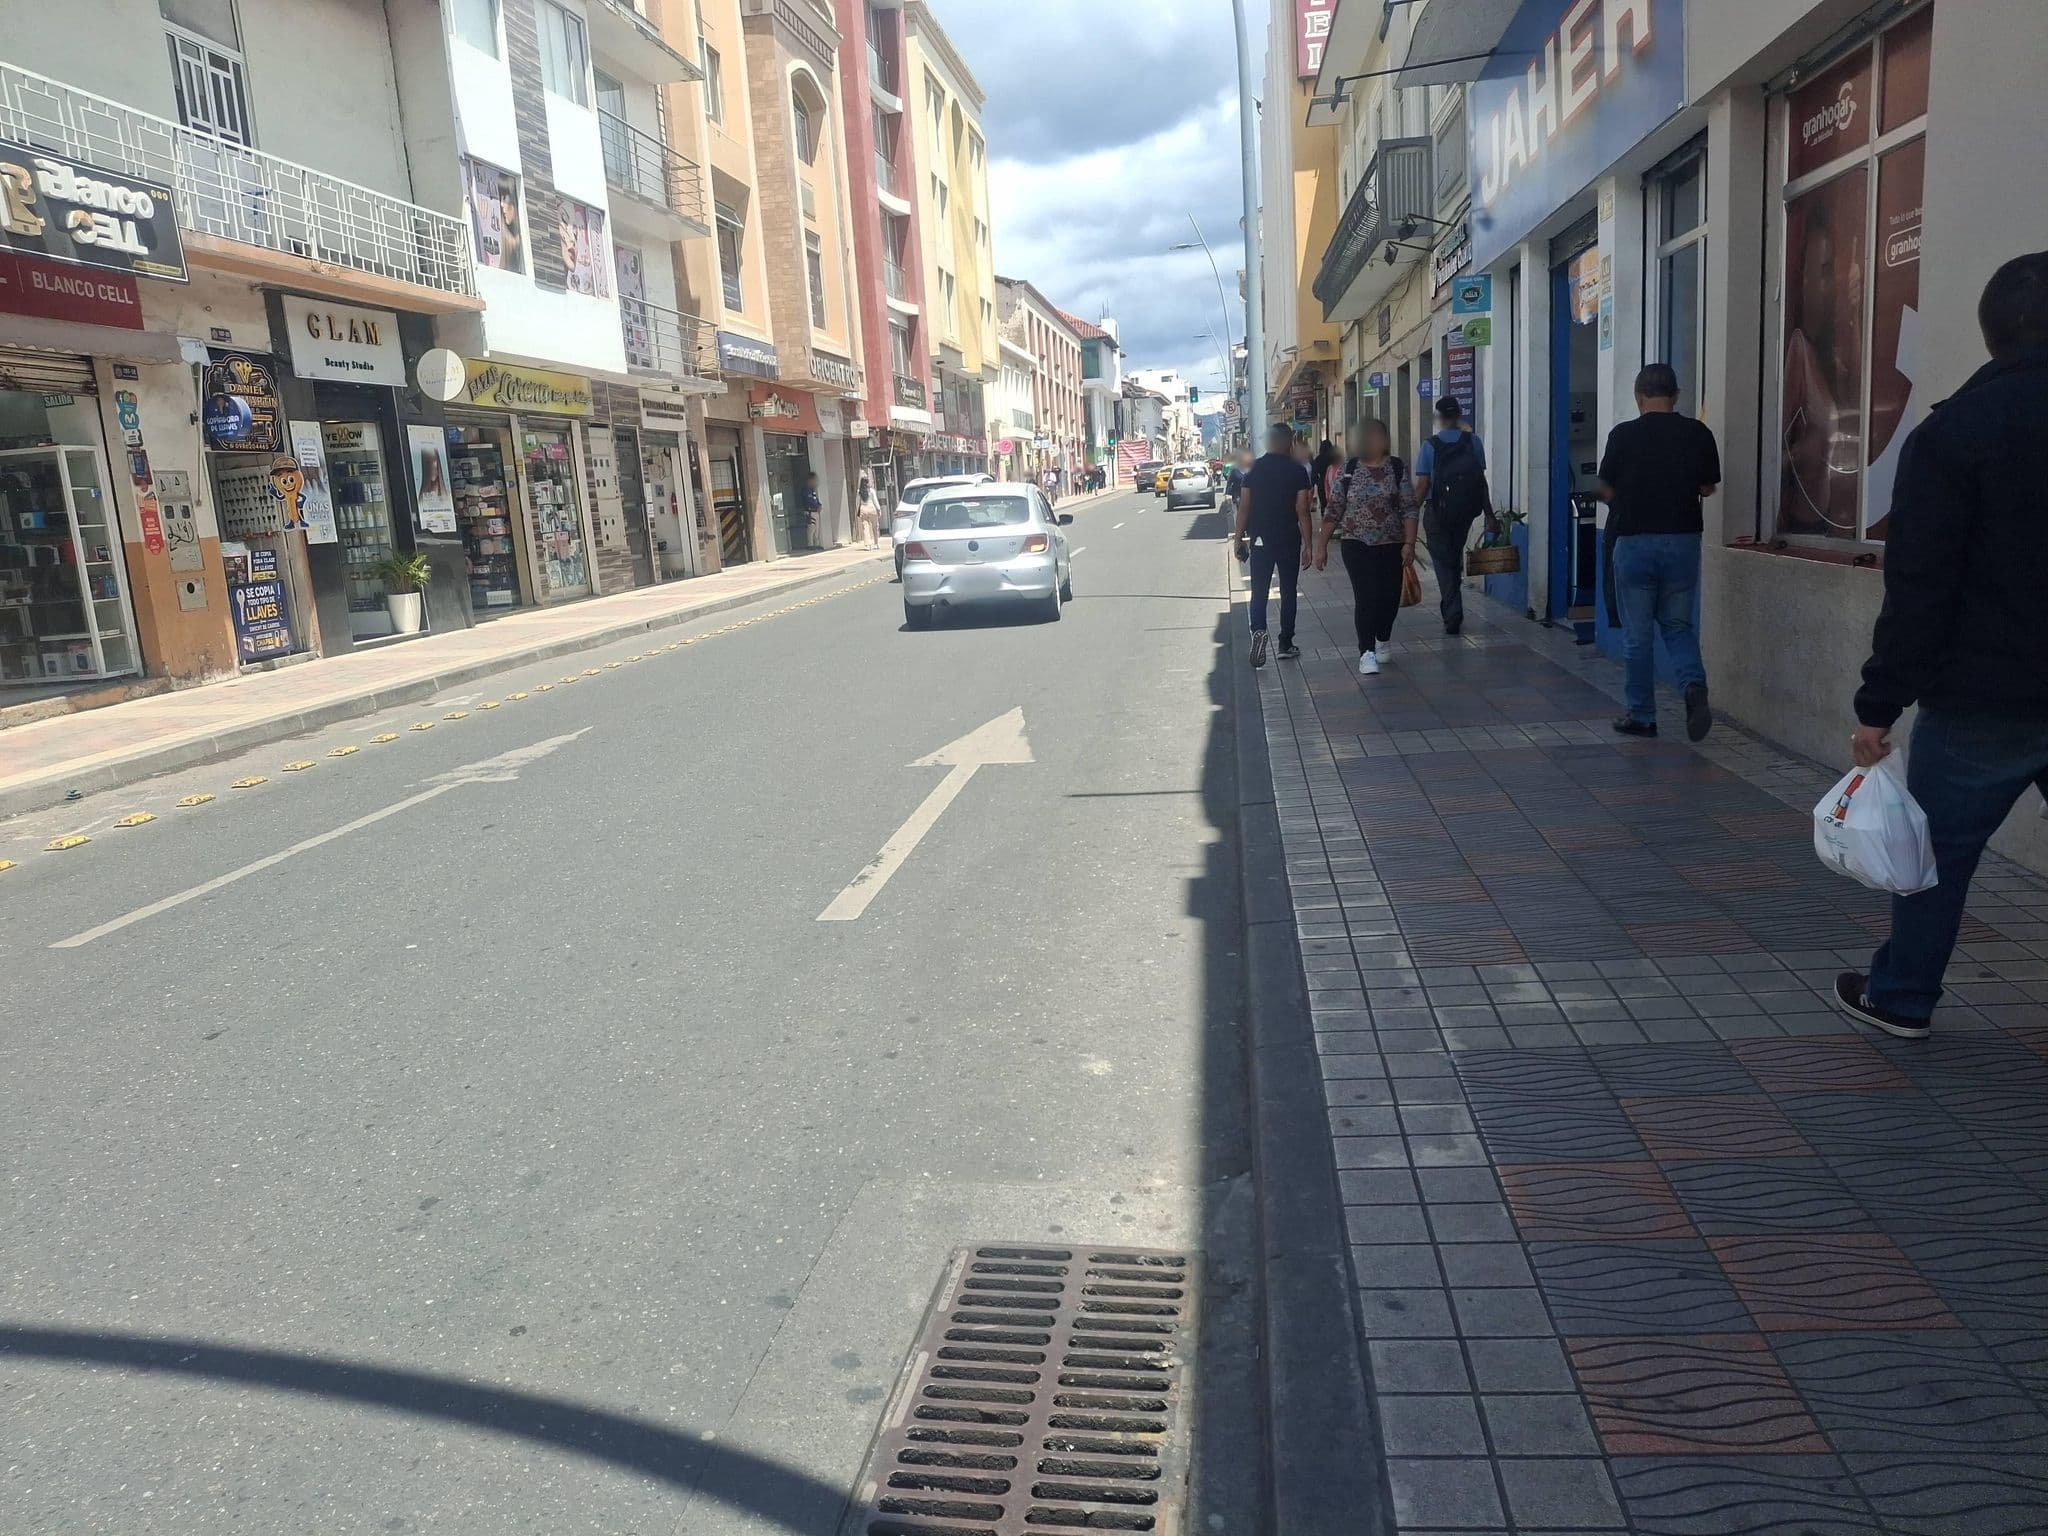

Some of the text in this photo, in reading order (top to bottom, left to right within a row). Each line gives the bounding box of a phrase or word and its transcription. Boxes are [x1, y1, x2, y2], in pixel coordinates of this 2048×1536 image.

[1802, 96, 1851, 145] granhogar
[32, 271, 134, 305] BLANCO CELL
[307, 312, 382, 346] GLAM
[324, 357, 374, 371] Beauty Studio
[810, 356, 856, 389] OFICENTRO
[229, 383, 265, 395] DANIEL
[467, 366, 498, 402] BAZAR
[44, 394, 74, 407] SALIDA
[246, 585, 275, 599] SE COPIA
[260, 597, 270, 605] TIPO
[246, 603, 278, 621] LLAVES
